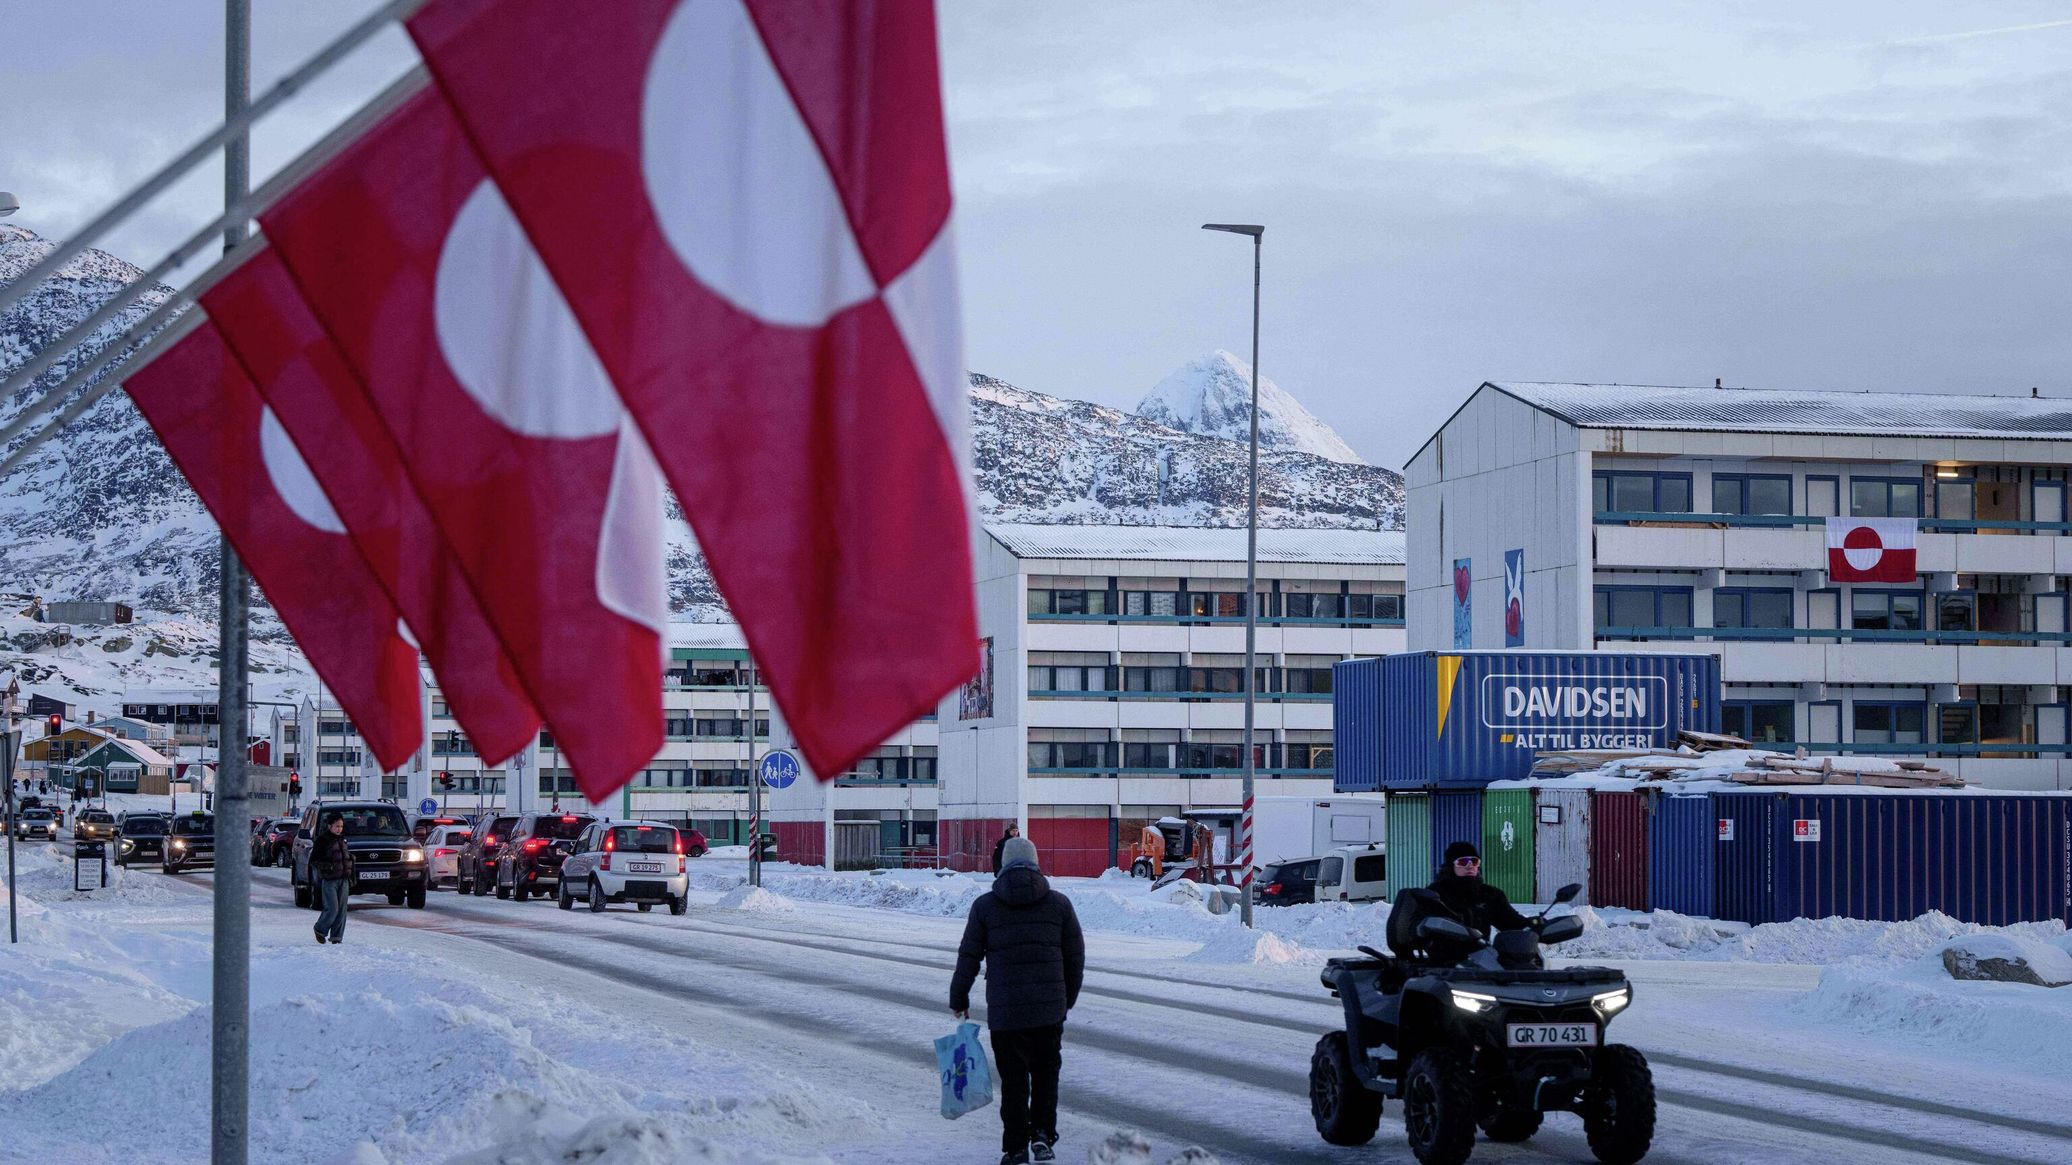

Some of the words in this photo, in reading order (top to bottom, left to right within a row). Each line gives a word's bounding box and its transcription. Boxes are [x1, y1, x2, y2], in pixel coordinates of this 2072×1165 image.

[1504, 686, 1646, 718] DAVIDSEN
[1515, 734, 1548, 749] ALT
[1550, 734, 1575, 749] TIL
[1580, 734, 1652, 749] BYGGERI
[254, 792, 276, 800] WATER
[1515, 1027, 1535, 1043] GR
[1539, 1027, 1557, 1043] 70
[1561, 1027, 1588, 1043] 431
